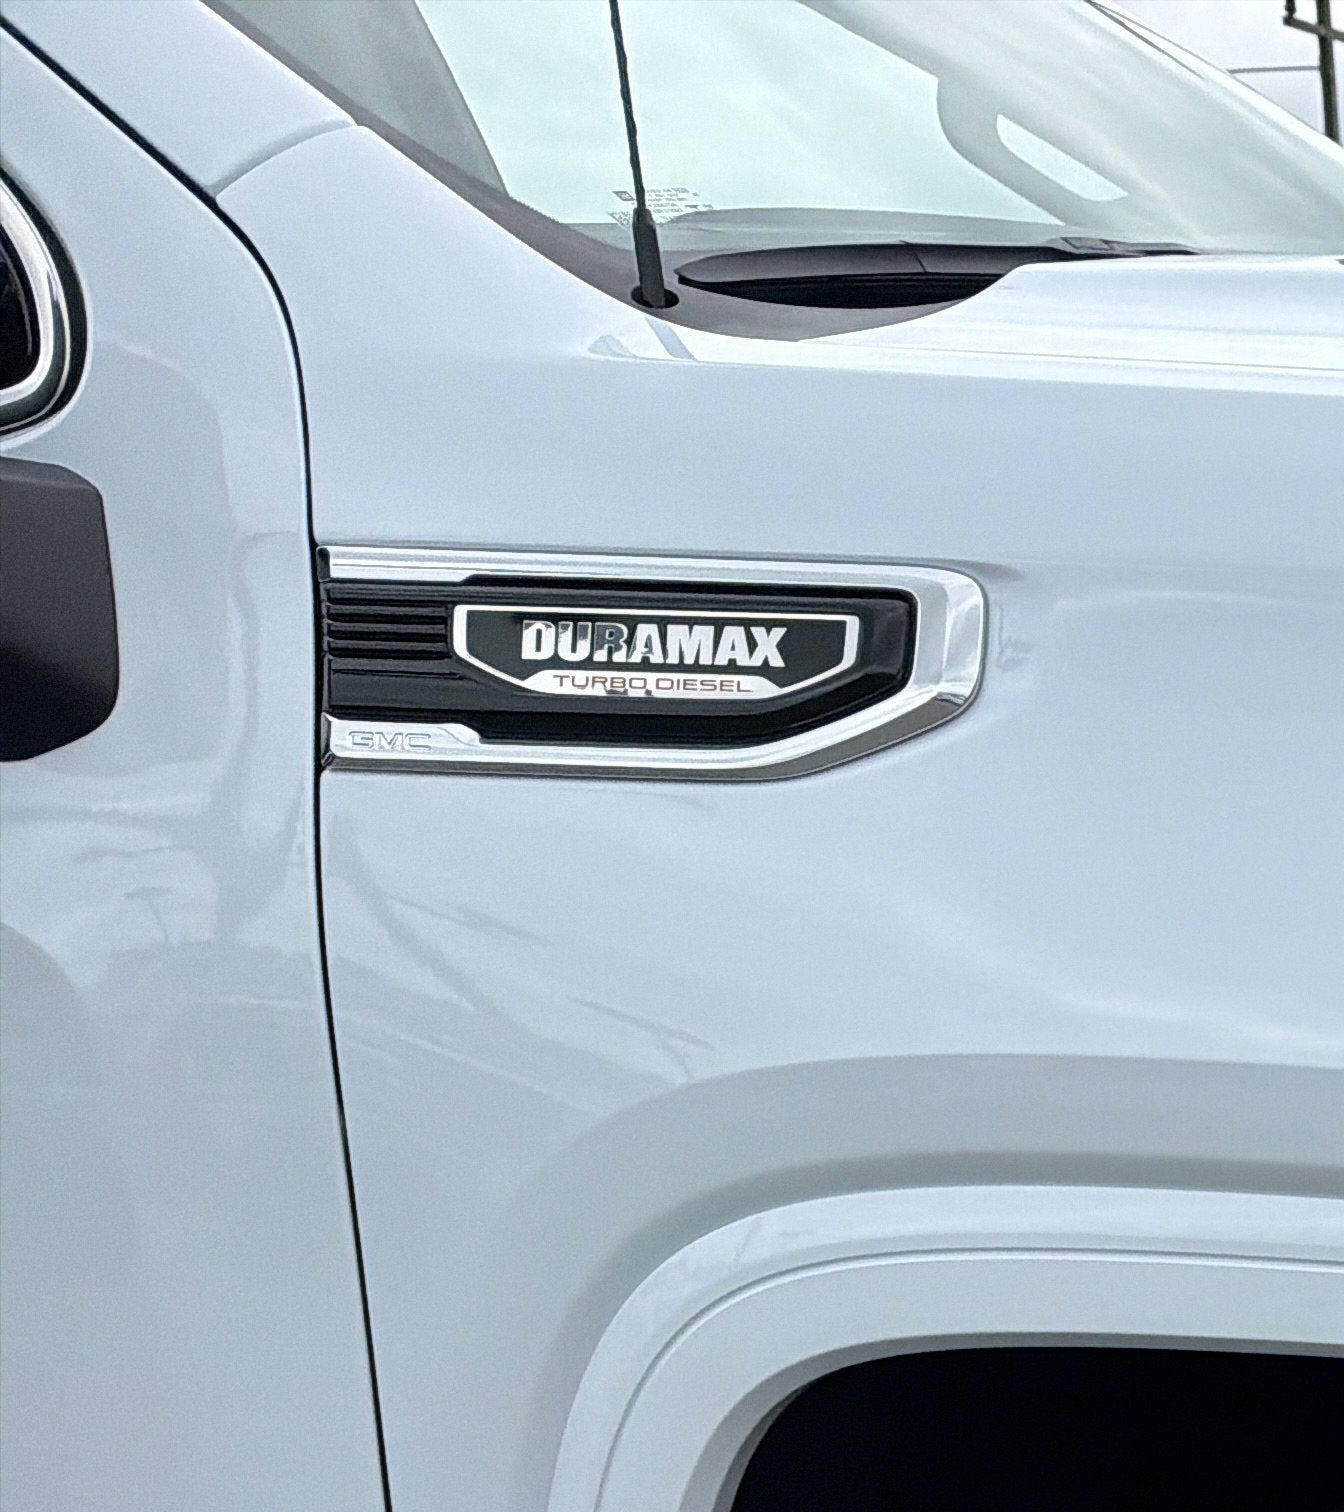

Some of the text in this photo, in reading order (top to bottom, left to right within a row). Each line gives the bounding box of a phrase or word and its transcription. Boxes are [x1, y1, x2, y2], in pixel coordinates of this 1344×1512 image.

[521, 619, 788, 668] DURAMAX
[552, 674, 754, 693] TURBO DIESEL
[348, 730, 432, 752] GMC
